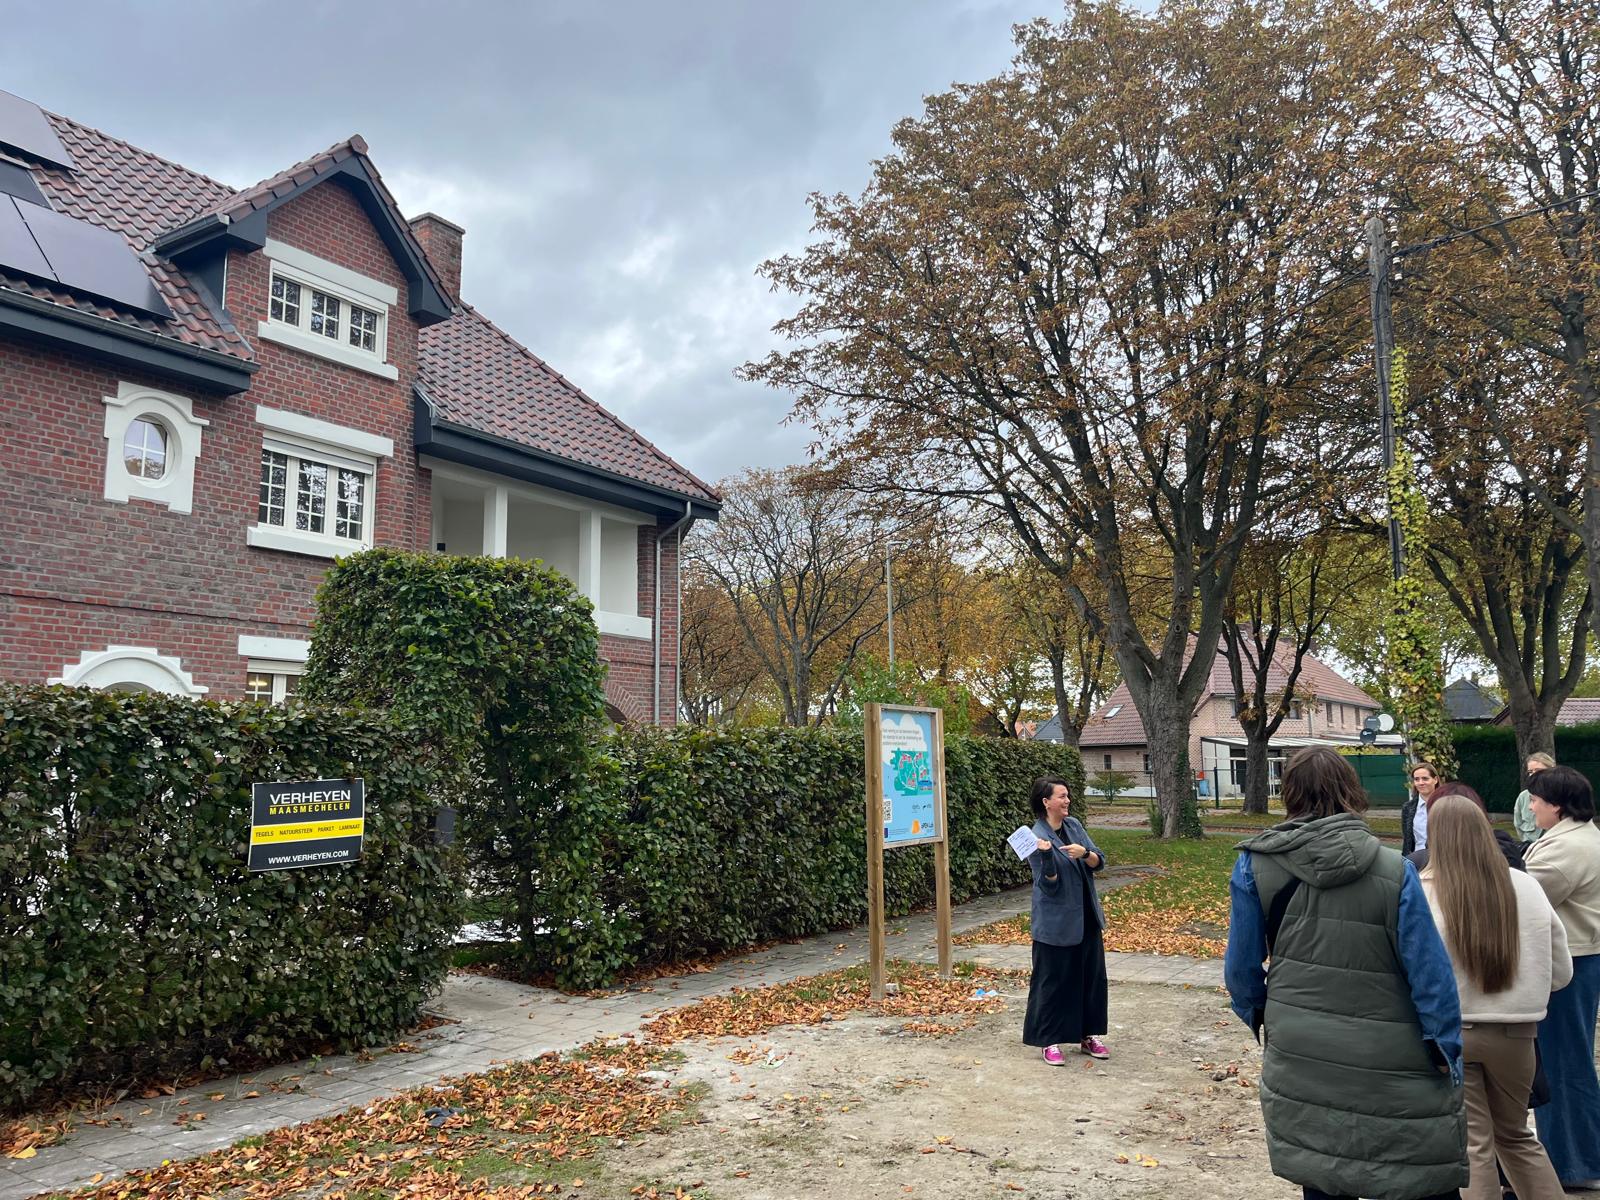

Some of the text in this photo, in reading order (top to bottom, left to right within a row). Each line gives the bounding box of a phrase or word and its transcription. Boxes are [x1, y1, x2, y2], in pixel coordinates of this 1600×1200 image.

[269, 789, 351, 805] VERHEYEN
[269, 802, 350, 815] MAASMECHELEN
[255, 823, 361, 838] TEGELS NATUURSTEEN PARKET LAMINAAT
[268, 850, 349, 865] WWW.VERHEYEN.COM
